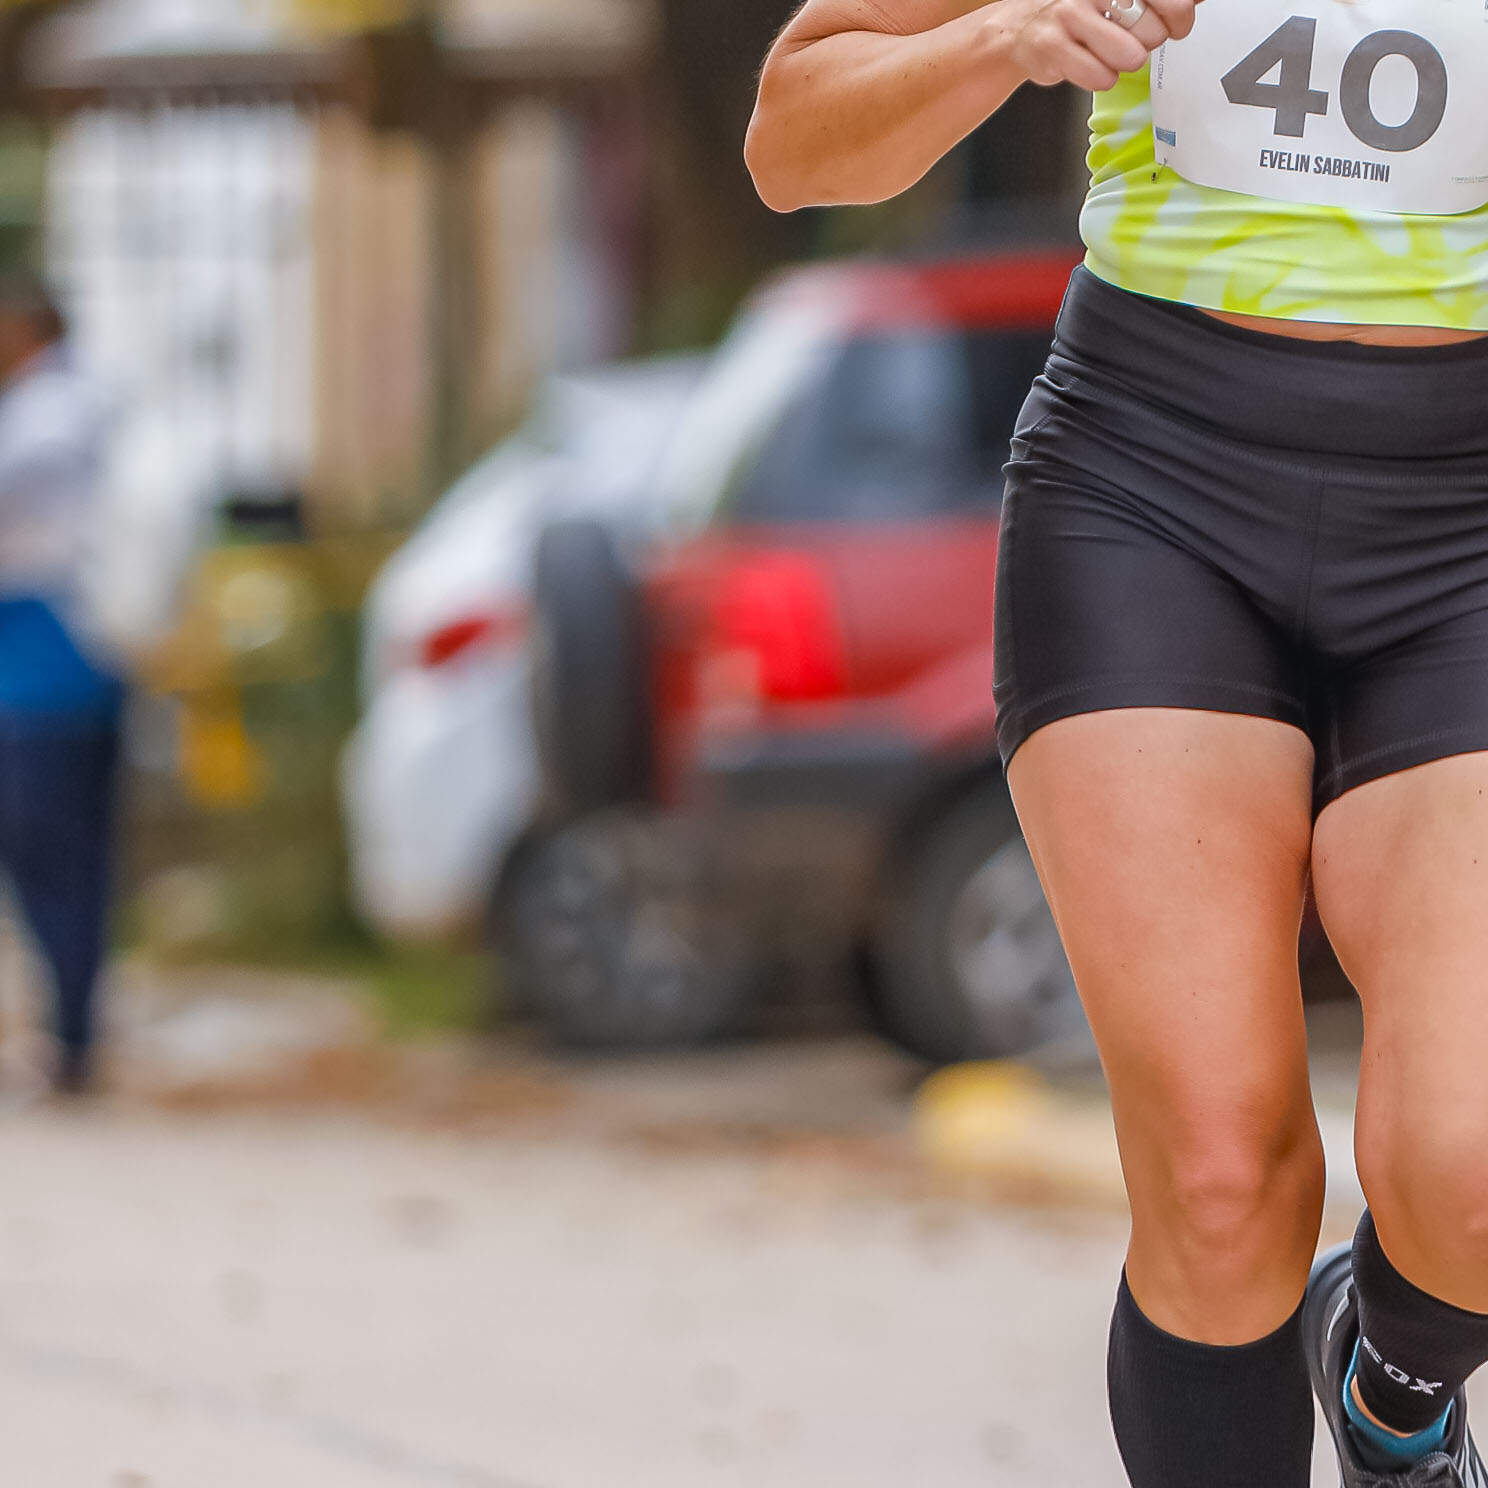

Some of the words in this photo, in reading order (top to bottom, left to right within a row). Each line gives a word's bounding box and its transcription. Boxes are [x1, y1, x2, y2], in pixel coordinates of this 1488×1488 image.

[1220, 15, 1448, 152] 40
[1259, 149, 1311, 173] EVELIN
[1313, 155, 1391, 183] SABBATINI
